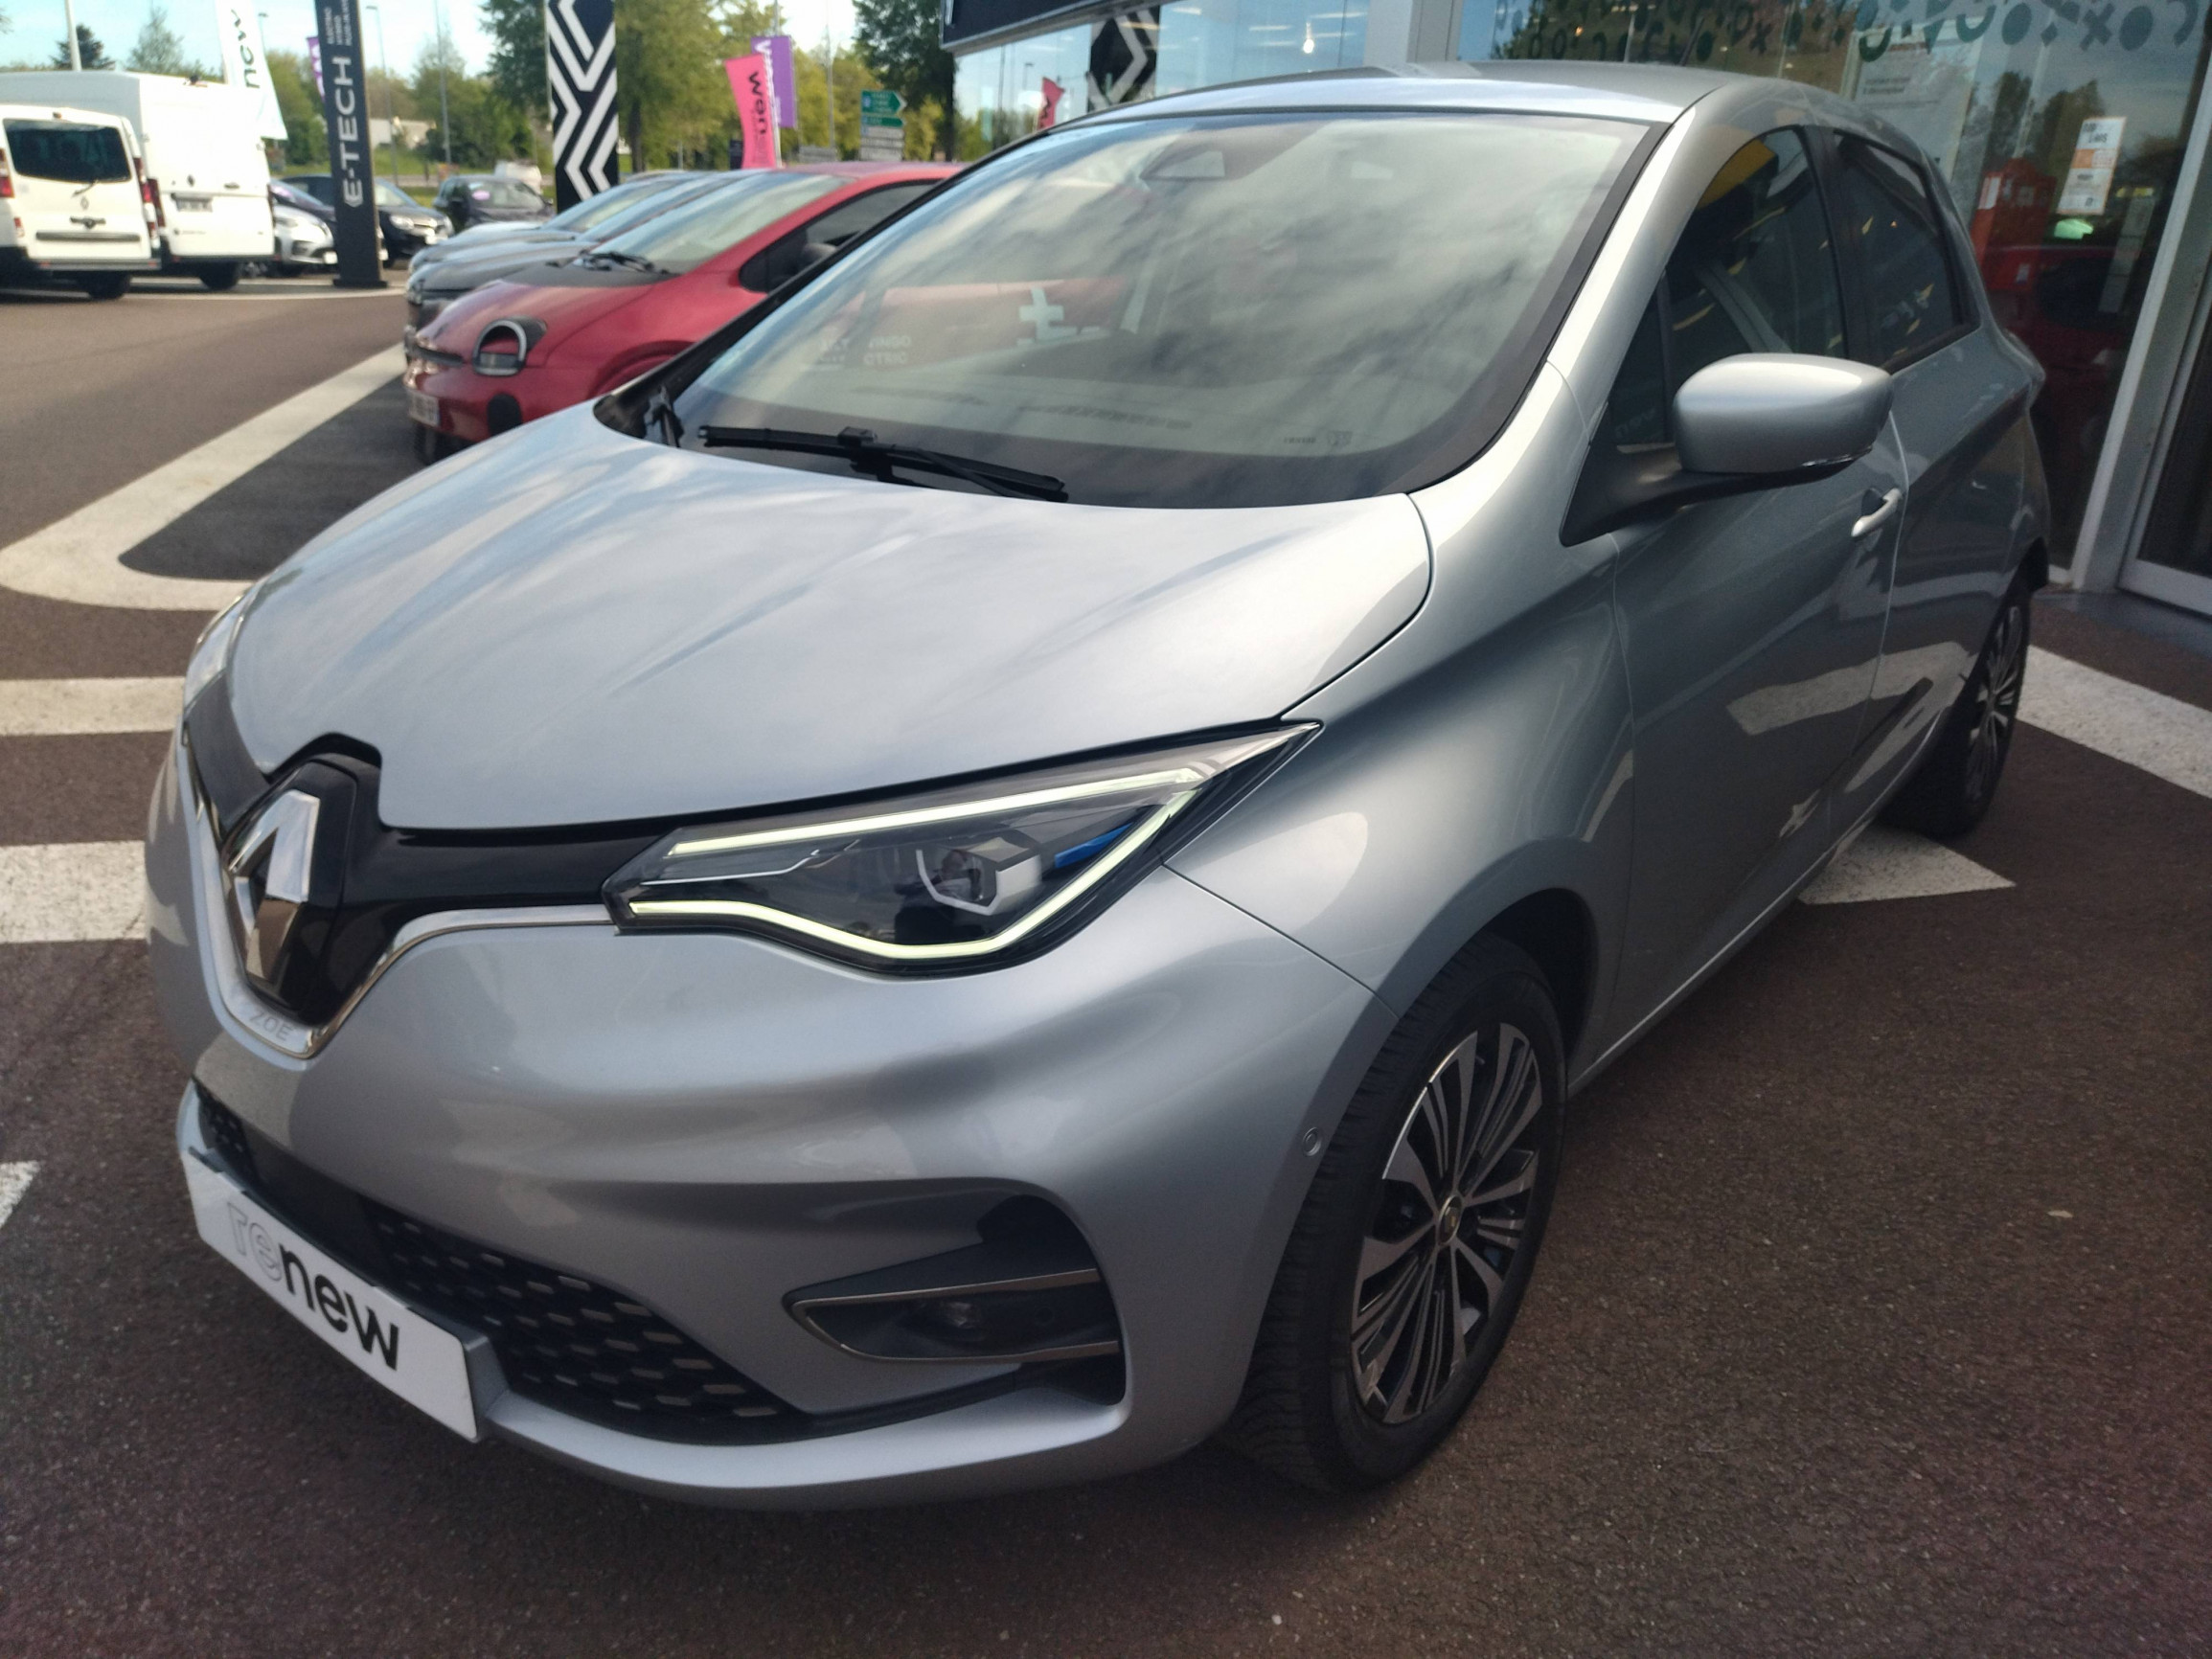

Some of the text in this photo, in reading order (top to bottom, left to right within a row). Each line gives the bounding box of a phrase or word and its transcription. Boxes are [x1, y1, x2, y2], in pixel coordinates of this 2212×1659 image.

[331, 56, 364, 207] E-TECH
[250, 1012, 293, 1041] ZOE
[228, 1204, 399, 1371] renew
